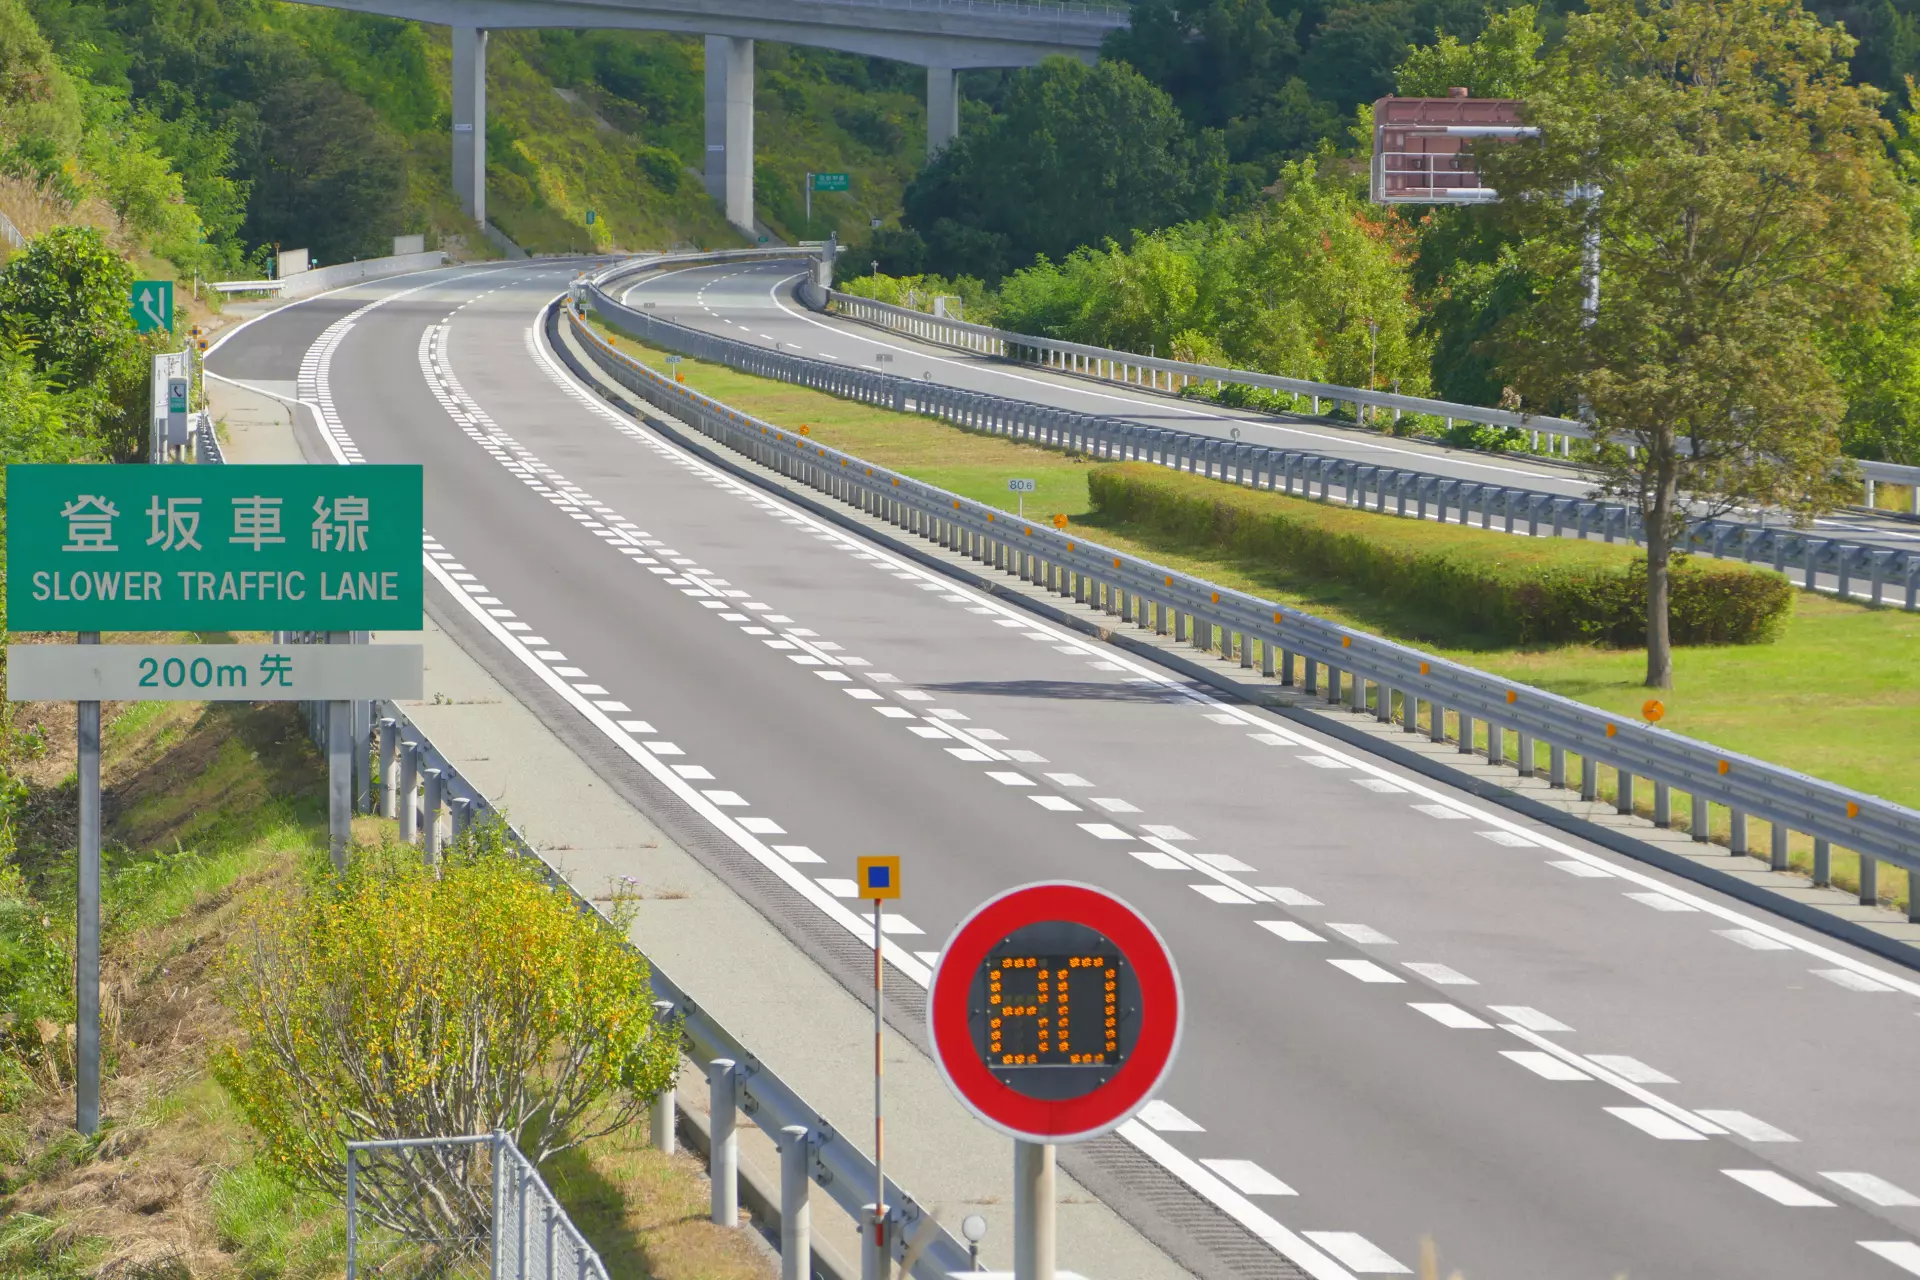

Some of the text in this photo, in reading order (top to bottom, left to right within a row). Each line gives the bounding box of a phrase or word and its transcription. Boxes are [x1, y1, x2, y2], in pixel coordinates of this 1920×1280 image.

[1009, 480, 1032, 490] 80.6
[60, 494, 369, 552] 登坂車線
[32, 570, 398, 601] SLOWER TRAFFIC LANE
[138, 653, 293, 688] 200m 先
[990, 957, 1117, 1064] 80
